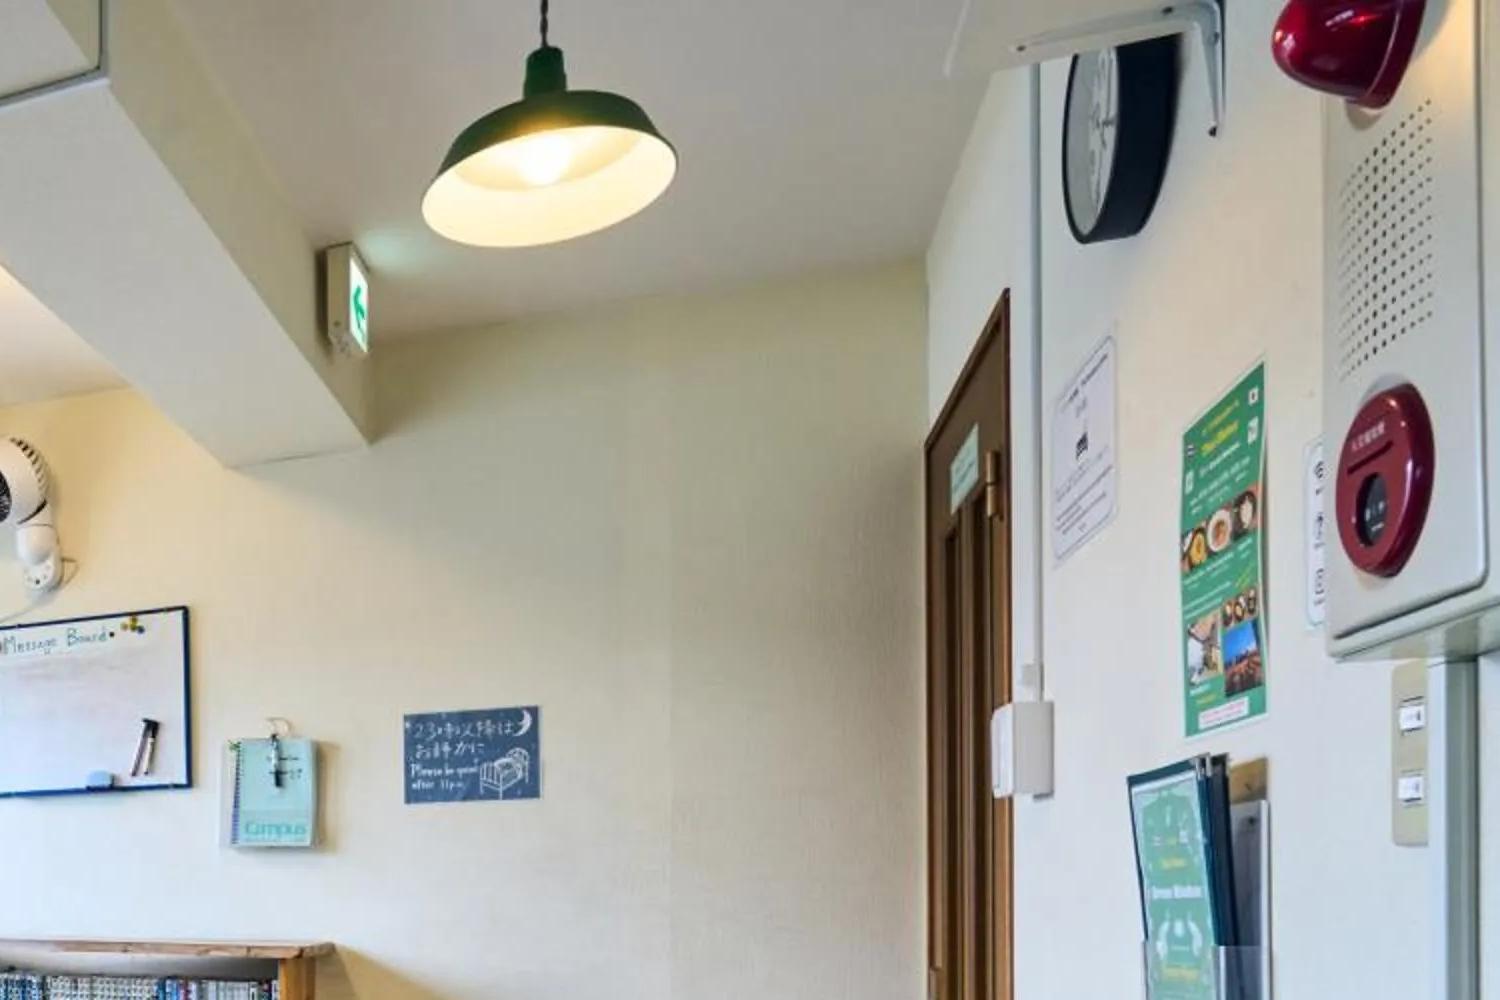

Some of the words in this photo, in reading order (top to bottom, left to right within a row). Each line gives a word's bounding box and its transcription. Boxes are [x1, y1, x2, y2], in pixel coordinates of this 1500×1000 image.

[3, 633, 57, 655] Message
[66, 627, 107, 647] Board
[245, 820, 307, 837] Campus
